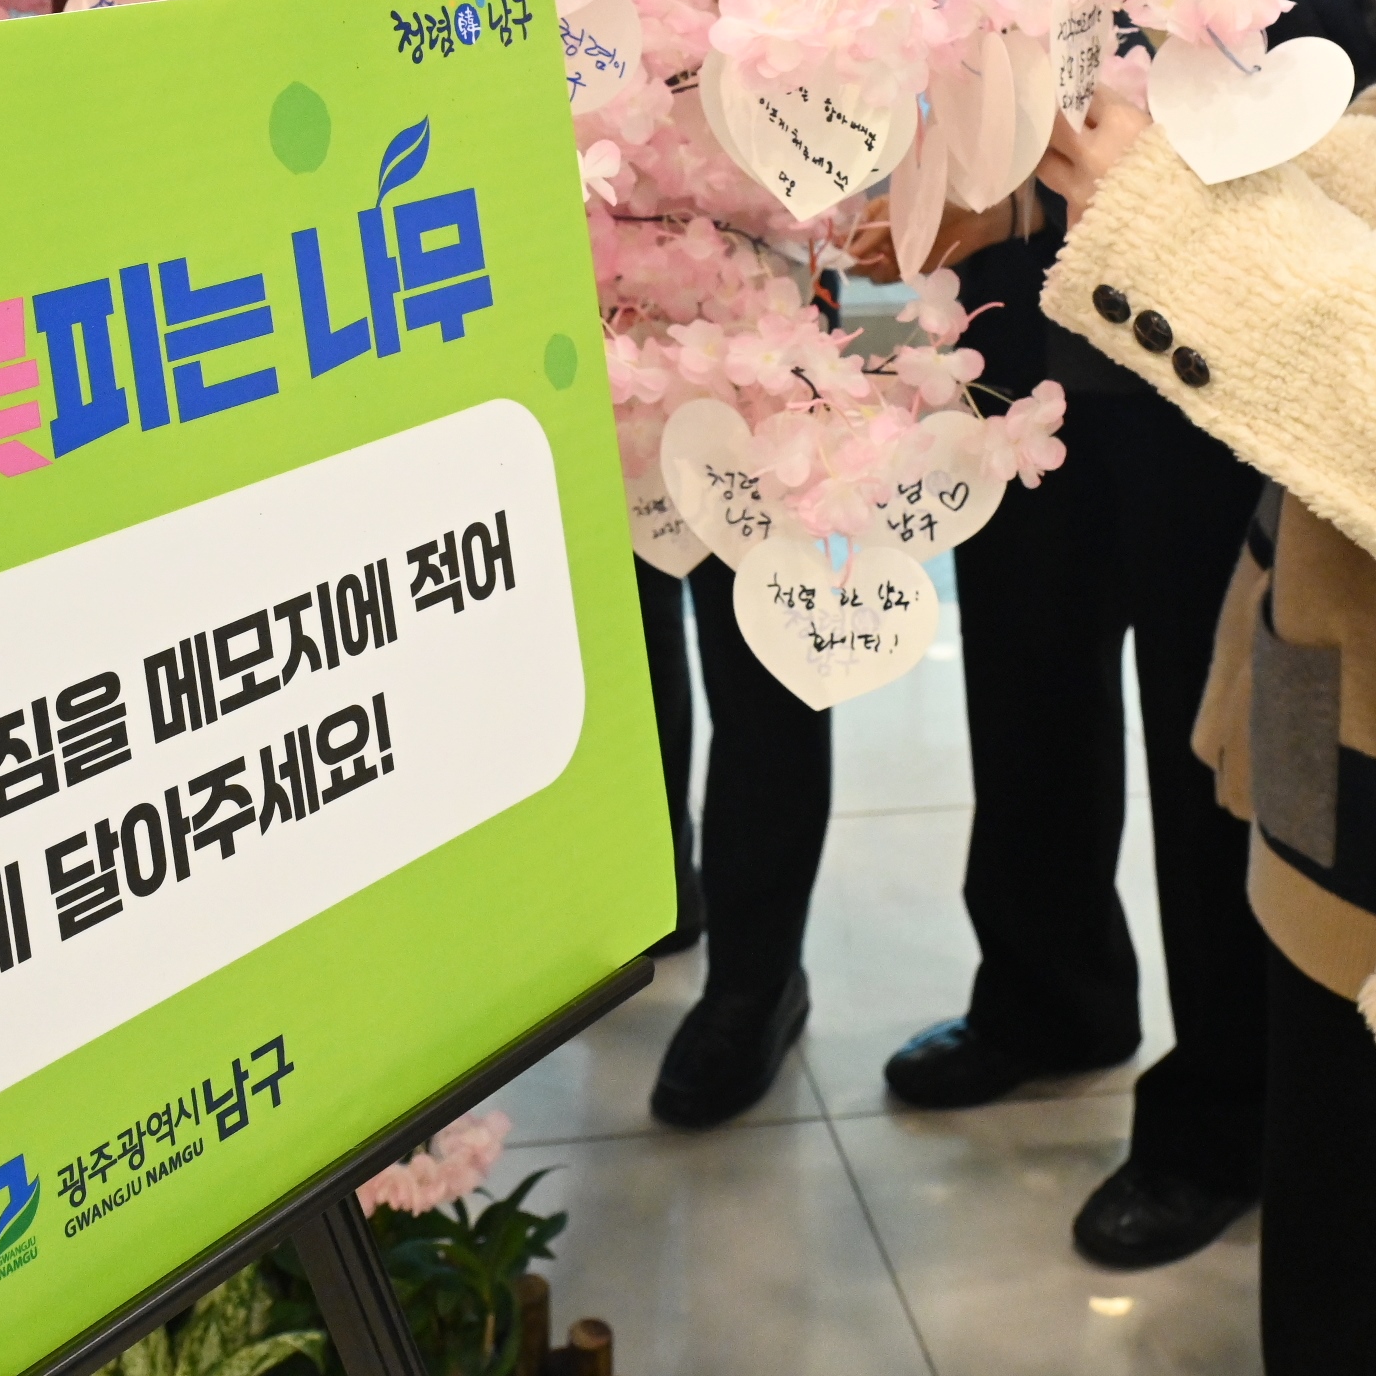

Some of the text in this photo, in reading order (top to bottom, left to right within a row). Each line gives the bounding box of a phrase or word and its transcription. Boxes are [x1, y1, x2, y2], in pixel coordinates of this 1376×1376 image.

[391, 5, 455, 64] 청렴
[292, 186, 494, 379] 나무
[887, 512, 939, 542] 남구
[144, 560, 398, 744] 메모지에
[407, 511, 516, 614] 적어
[45, 693, 394, 941] 달아주세요!
[57, 1034, 295, 1209] 광주광역시 남구
[63, 1137, 205, 1239] GWANGJU NAMGU
